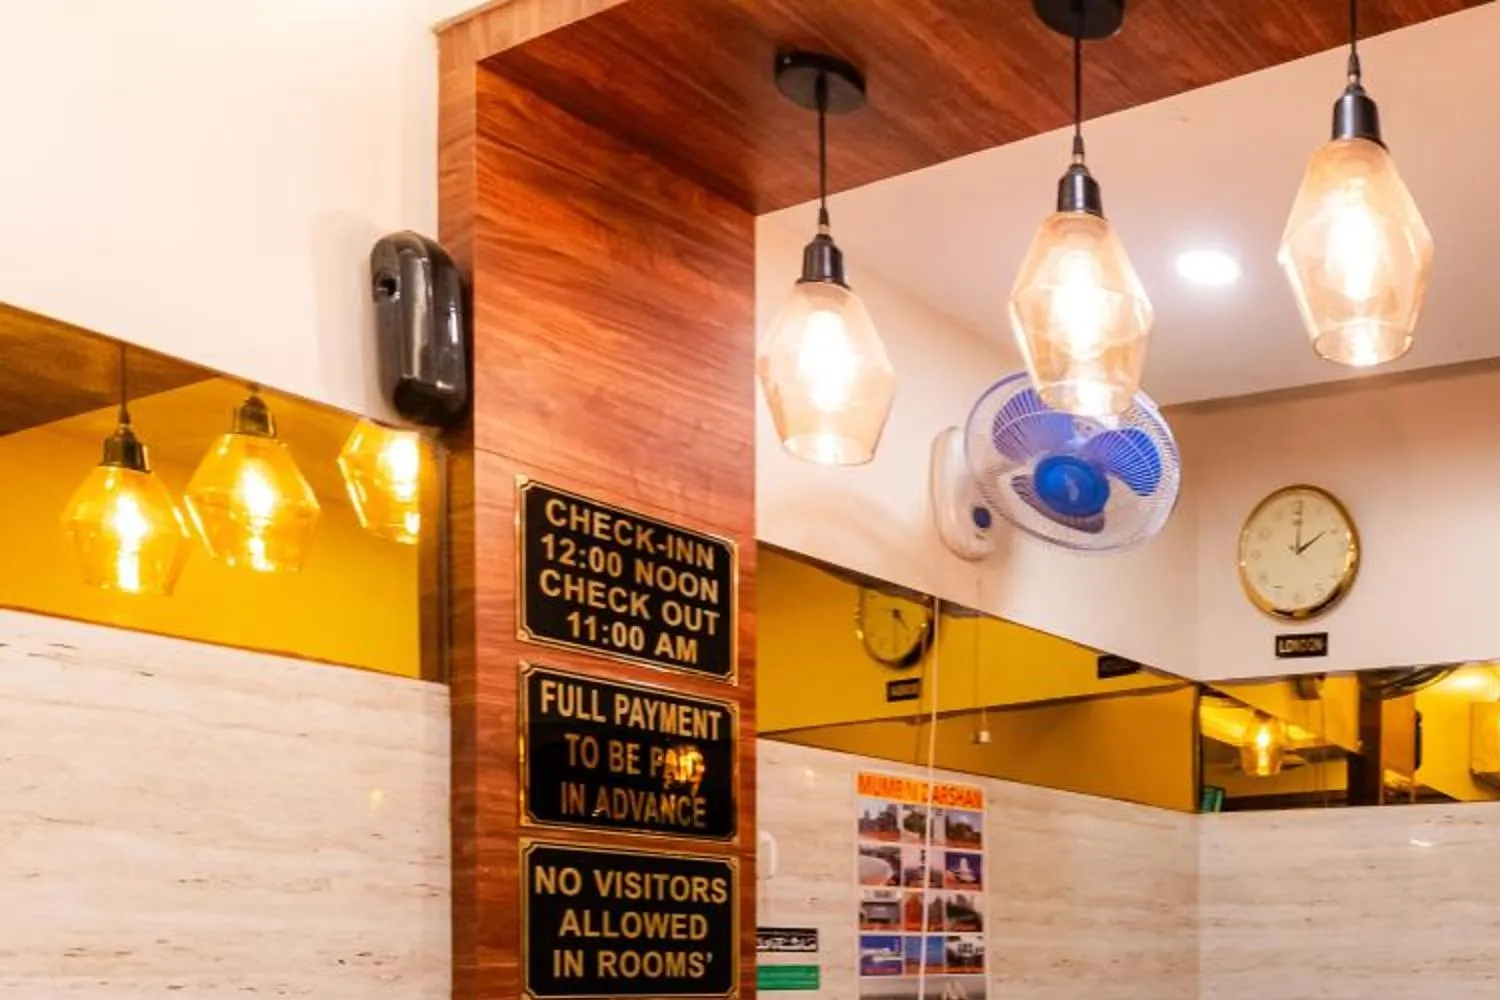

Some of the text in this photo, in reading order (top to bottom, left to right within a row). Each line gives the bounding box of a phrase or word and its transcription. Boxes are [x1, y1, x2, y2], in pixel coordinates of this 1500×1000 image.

[545, 499, 714, 570] CHECK-INN
[541, 533, 719, 604] 12:00 NOON
[539, 569, 720, 635] CHECK OUT
[566, 611, 698, 664] 11:00 AM
[540, 679, 722, 741] FULL PAYMENT
[564, 733, 599, 769] TO
[608, 738, 641, 775] BE
[561, 781, 707, 828] IN ADVANCE
[534, 865, 728, 904] NO VISITORS
[558, 908, 708, 940] ALLOWED
[553, 949, 584, 978] IN
